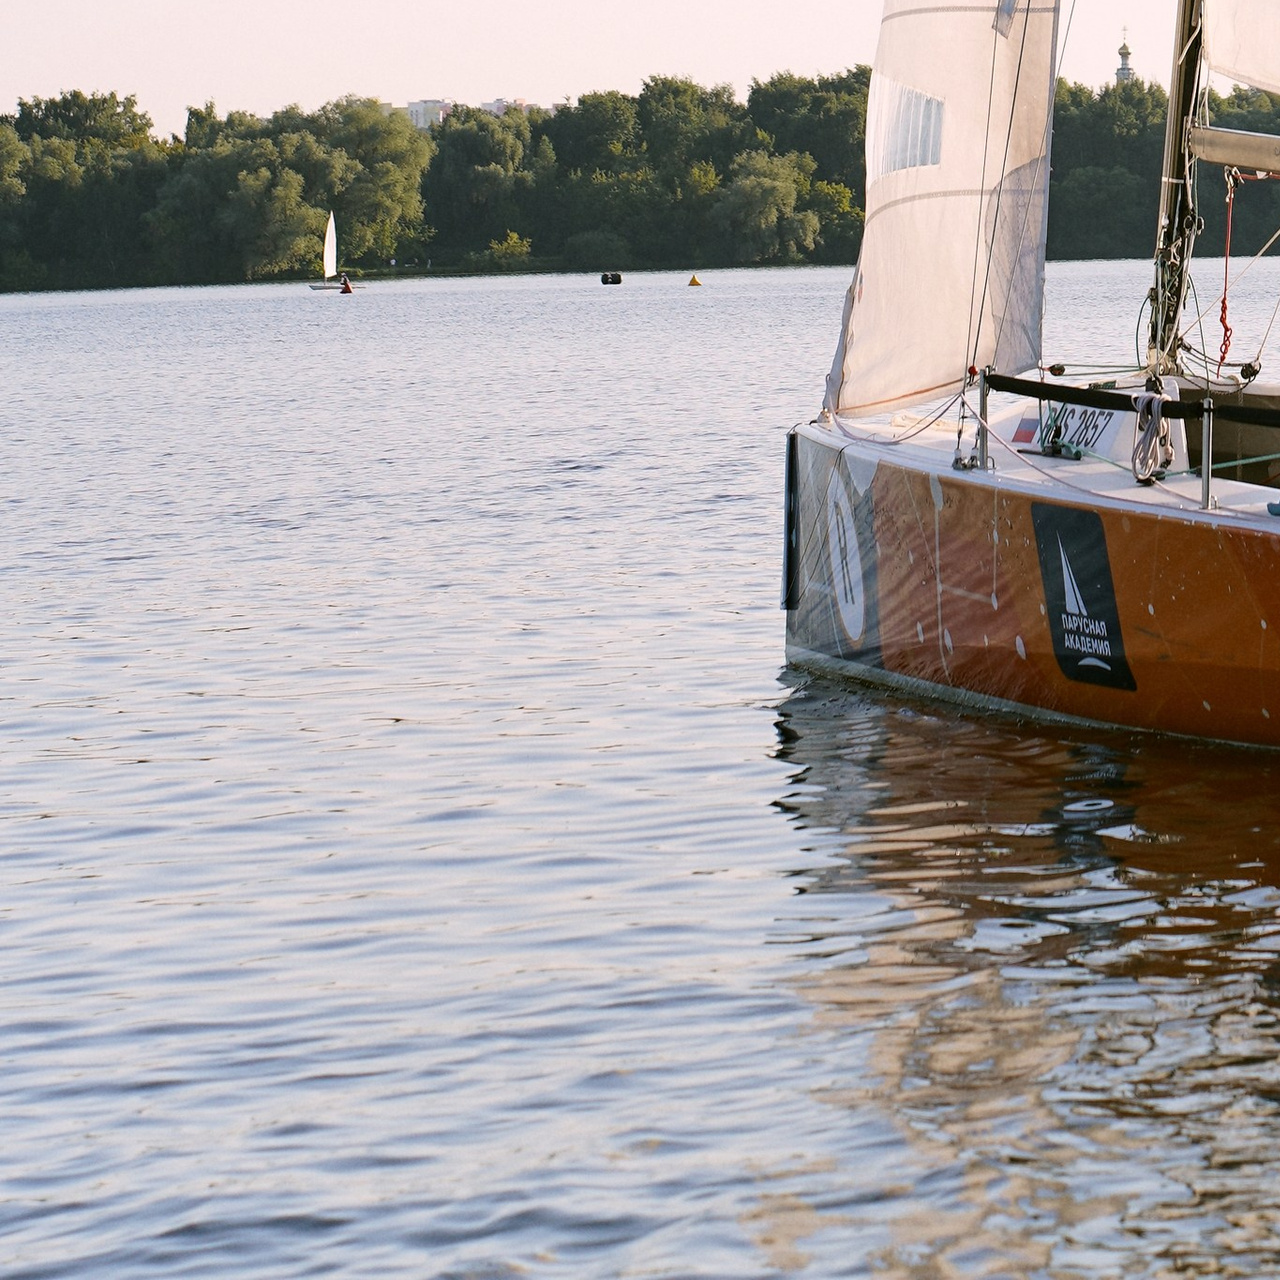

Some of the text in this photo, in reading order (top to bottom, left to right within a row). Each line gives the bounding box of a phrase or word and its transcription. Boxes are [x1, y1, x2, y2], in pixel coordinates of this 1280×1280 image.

[1068, 408, 1114, 448] 2857
[1061, 613, 1108, 638] ПАРУСНАЯ
[1065, 632, 1112, 657] АКАДЕМИЯ
